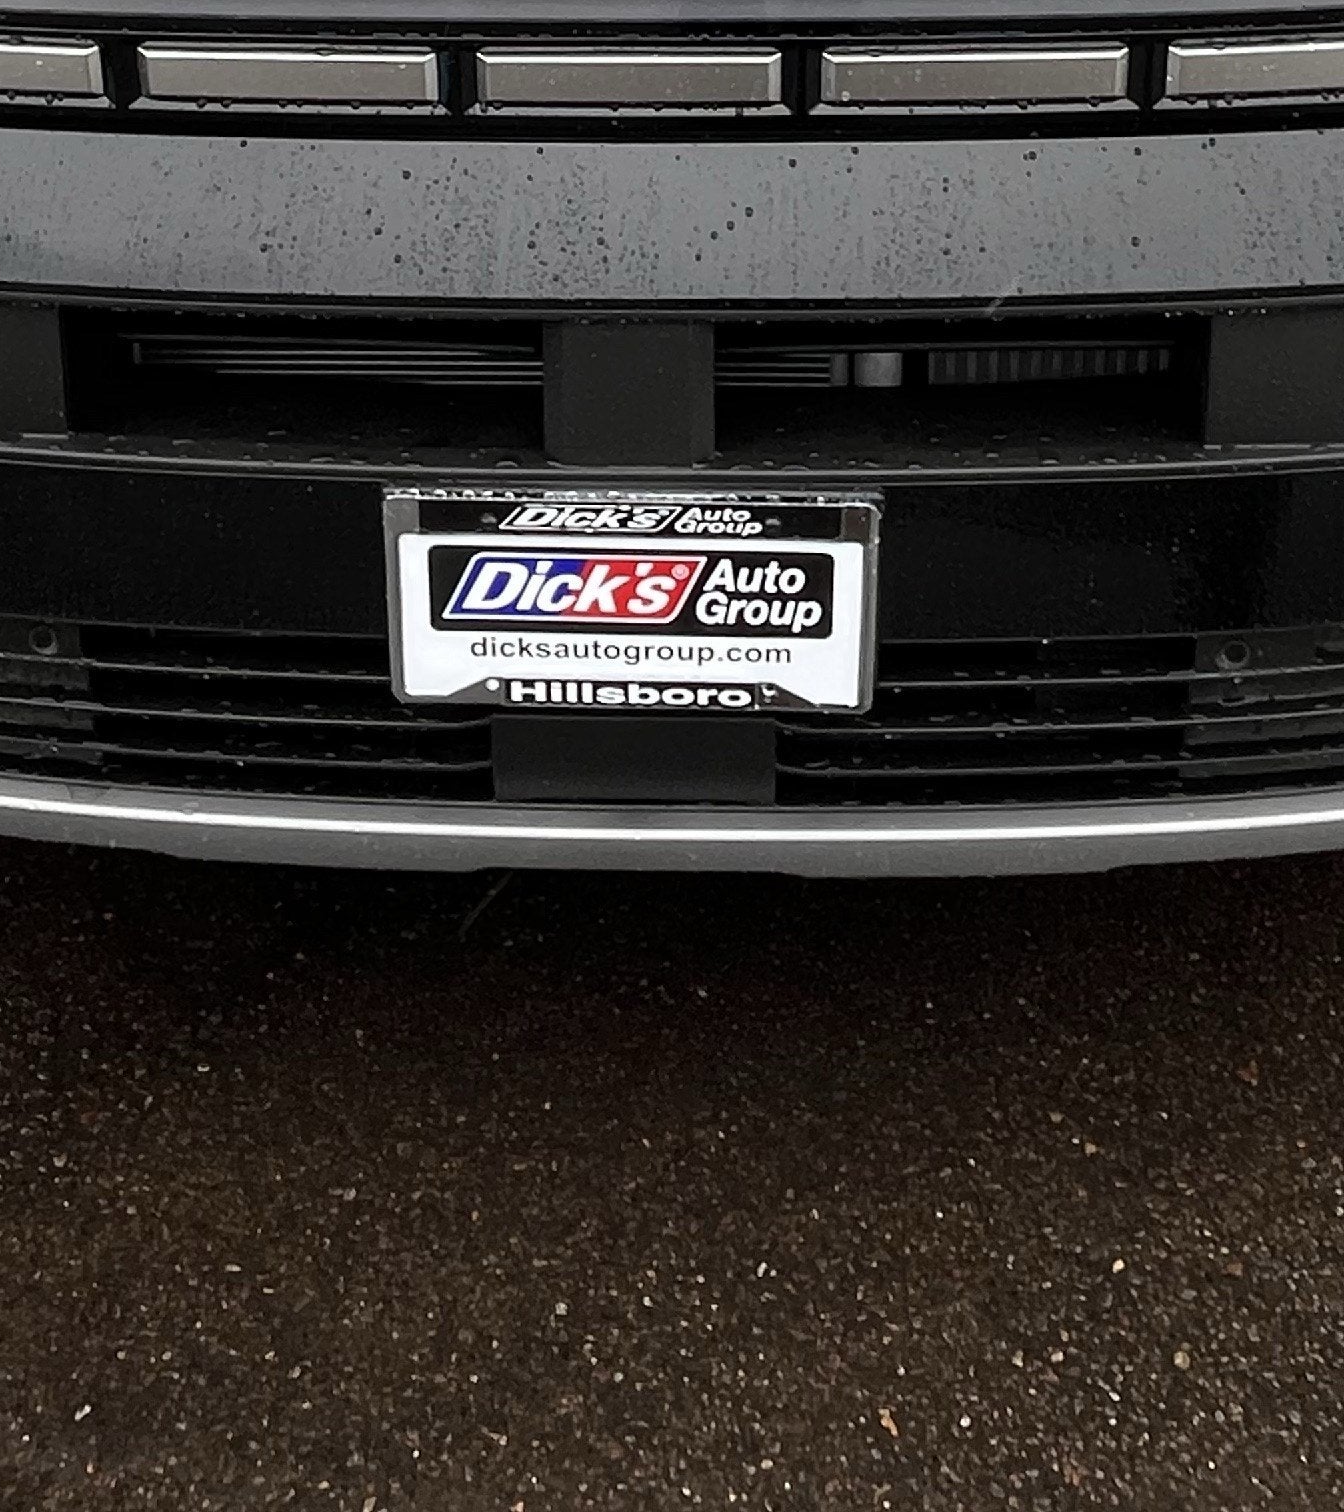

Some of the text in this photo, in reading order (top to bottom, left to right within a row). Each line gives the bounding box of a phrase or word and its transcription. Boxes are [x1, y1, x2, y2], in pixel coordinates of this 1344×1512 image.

[673, 520, 764, 538] Group
[682, 506, 752, 523] Auto
[462, 558, 806, 616] Dick's Auto
[695, 591, 823, 634] Group
[469, 635, 793, 667] dicksautogroup.com
[509, 680, 755, 708] Hillsboro
